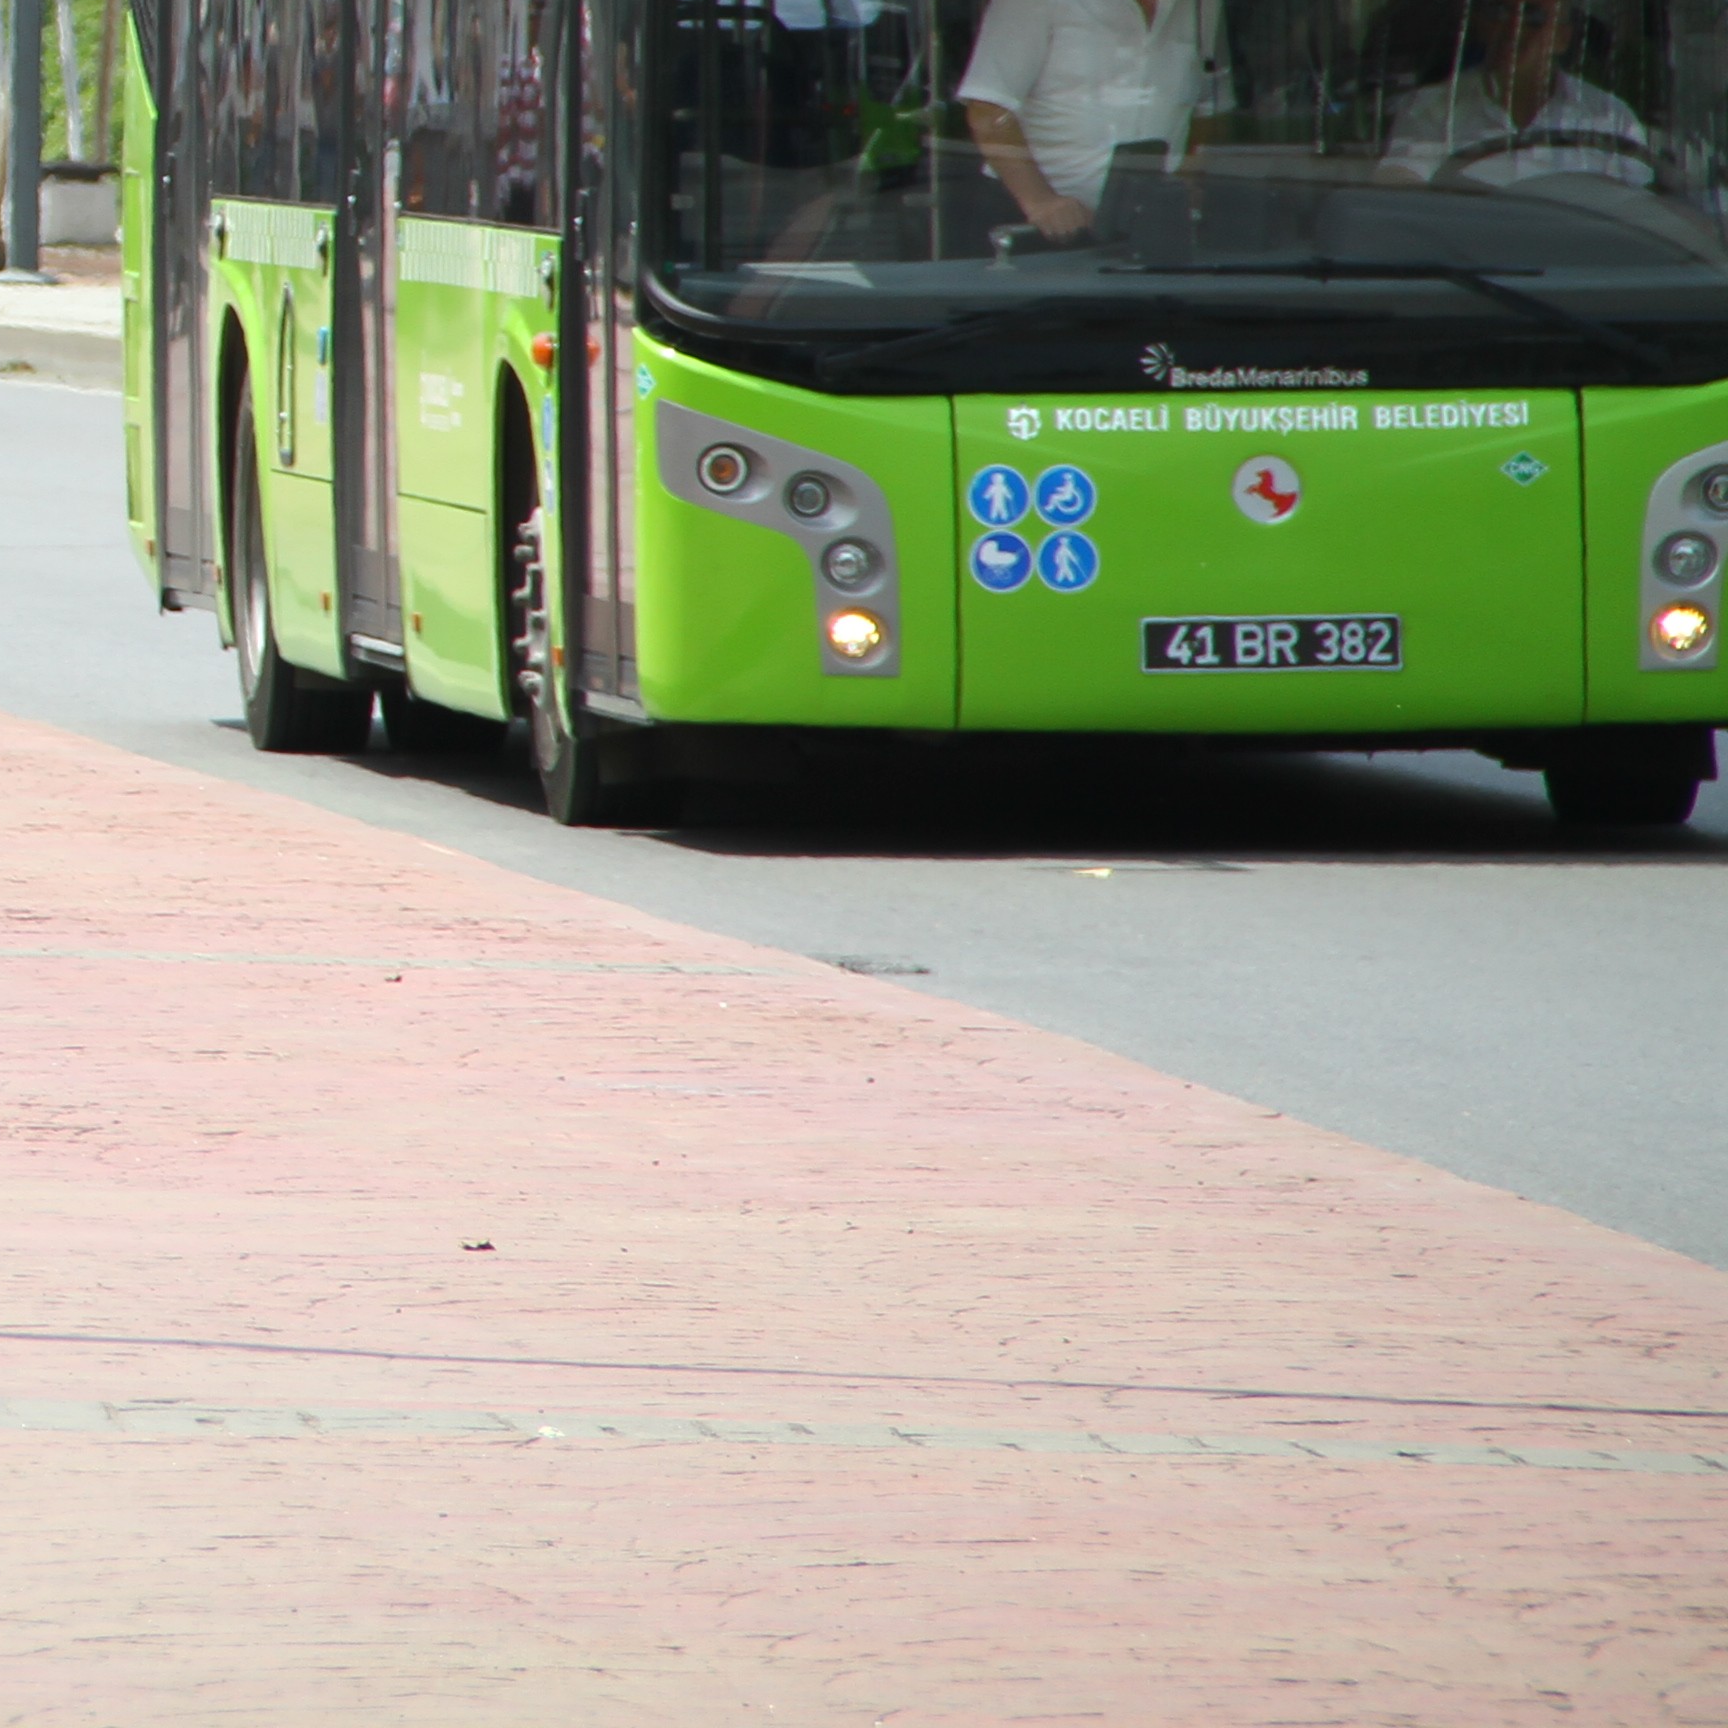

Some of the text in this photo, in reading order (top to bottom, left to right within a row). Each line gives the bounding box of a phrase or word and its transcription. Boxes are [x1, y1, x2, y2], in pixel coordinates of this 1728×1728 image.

[1166, 621, 1394, 665] 41 BR 382
